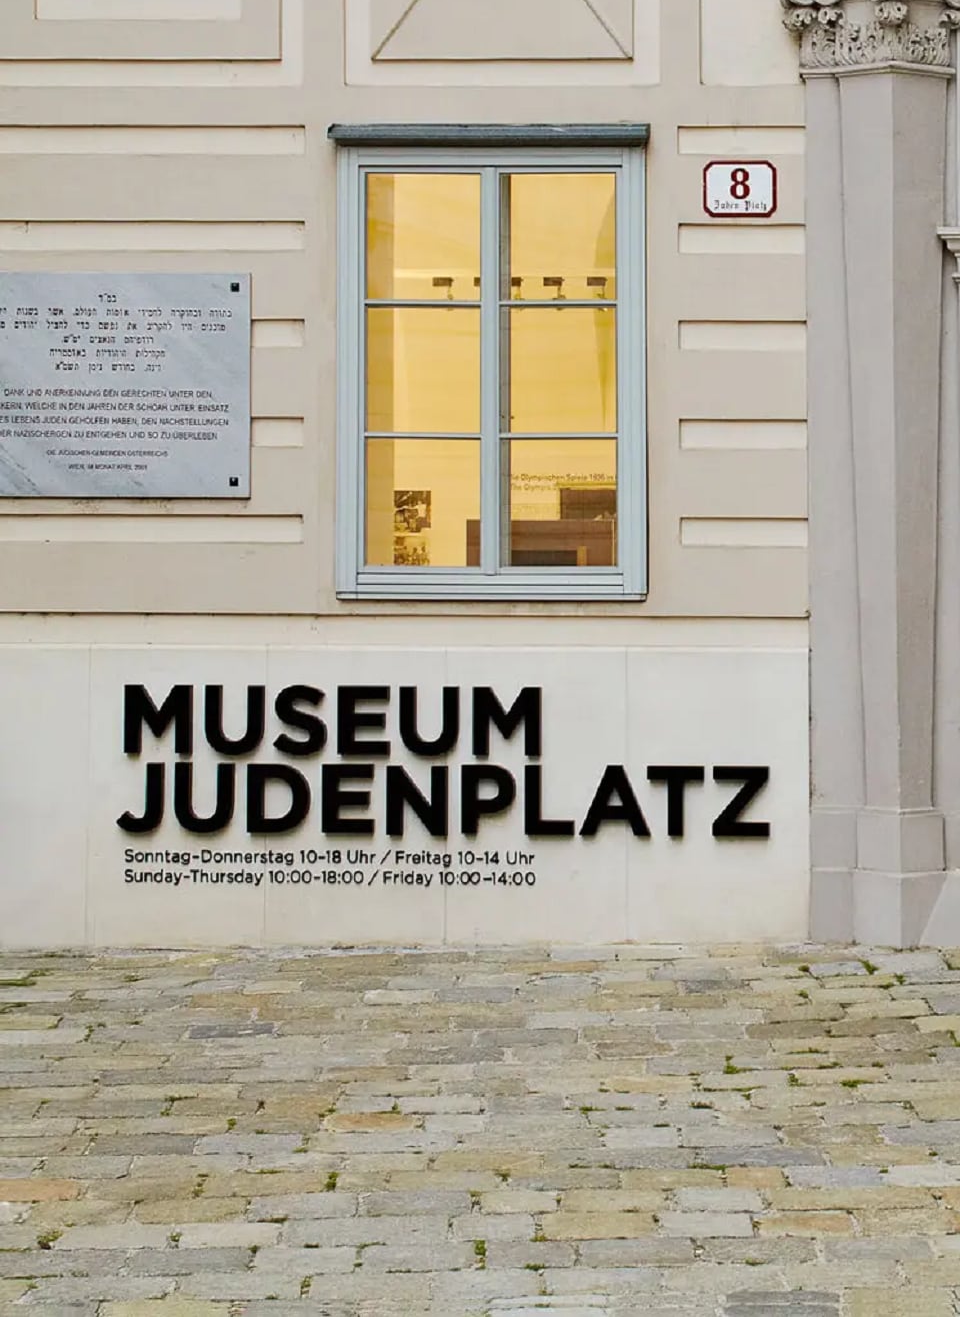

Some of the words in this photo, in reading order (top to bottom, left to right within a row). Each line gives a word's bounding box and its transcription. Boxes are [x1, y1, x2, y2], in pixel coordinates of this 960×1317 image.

[730, 168, 750, 199] 8
[4, 388, 25, 397] DANK
[26, 388, 42, 397] UND
[44, 388, 101, 398] ANERKENNUNG
[102, 388, 119, 398] DEN
[120, 389, 167, 398] GERECHTEN
[169, 390, 194, 398] UNTER
[24, 402, 57, 411] WELCHE
[68, 402, 85, 411] DEN
[87, 402, 117, 411] JAHREN
[117, 402, 135, 411] DER
[198, 403, 230, 413] EINSATZ
[42, 416, 67, 425] JUDEN
[68, 416, 110, 426] GEHOLFEN
[141, 417, 158, 426] DEN
[86, 431, 127, 440] ENTGEHEN
[129, 431, 146, 440] UND
[122, 684, 543, 757] MUSEUM
[115, 762, 771, 838] JUDENPLATZ
[124, 848, 295, 866] Sonntag-Donnerstag
[300, 849, 342, 865] 10-18
[346, 849, 377, 865] Uhr
[379, 849, 392, 865] /
[395, 850, 452, 868] Freitag
[458, 850, 500, 866] 10-14
[506, 850, 536, 866] Uhr
[124, 868, 264, 886] Sunday-Thursday
[268, 869, 365, 885] 10:00-18:00
[367, 869, 380, 886] /
[382, 870, 434, 888] Friday
[438, 871, 537, 886] 10:00-14:00
